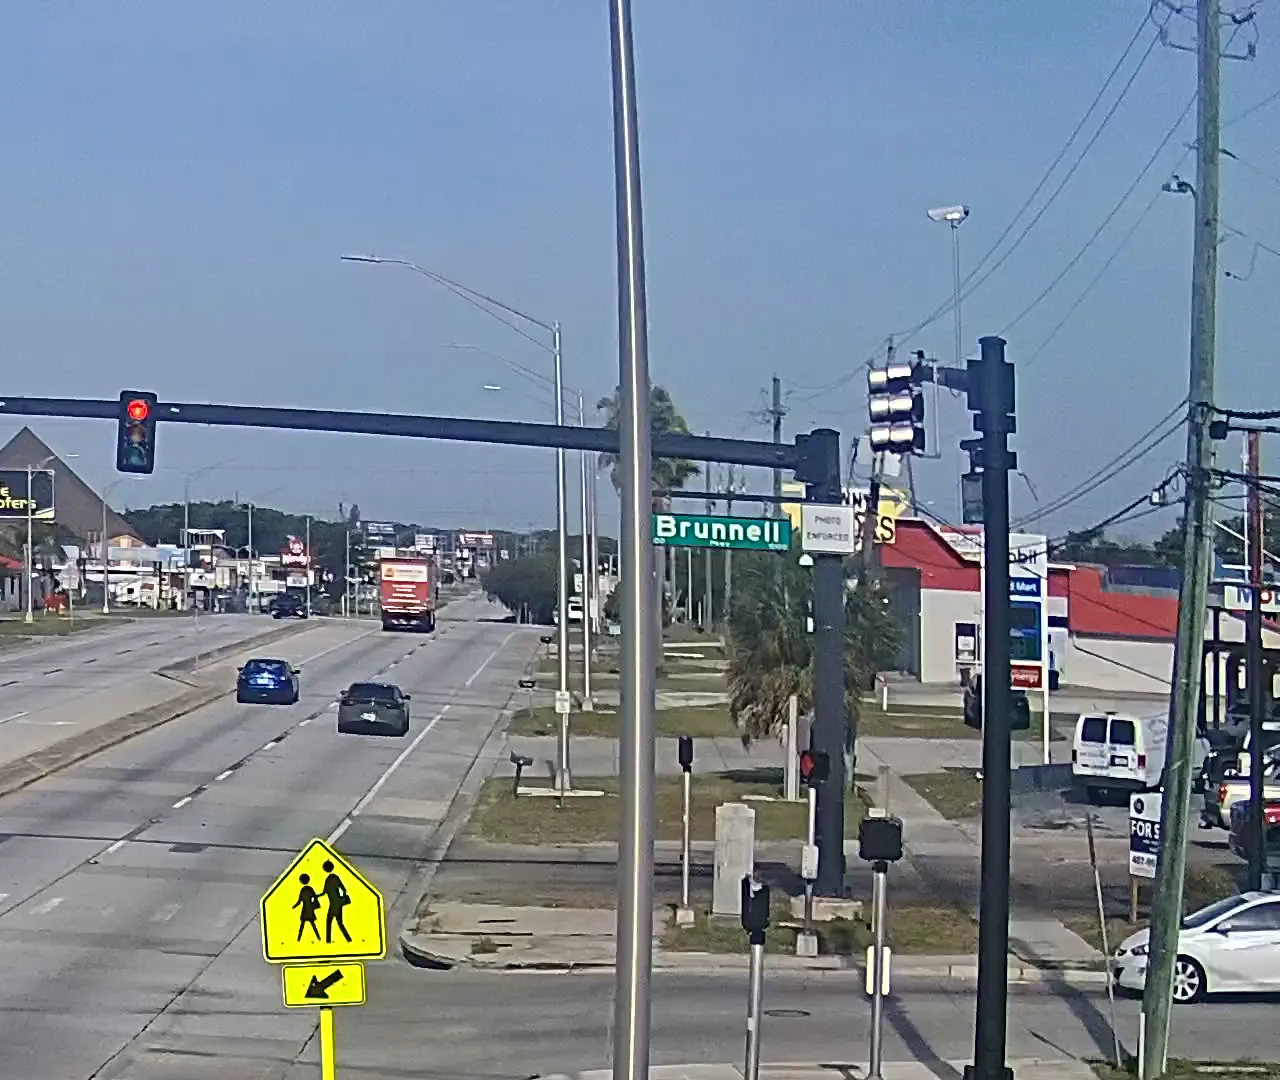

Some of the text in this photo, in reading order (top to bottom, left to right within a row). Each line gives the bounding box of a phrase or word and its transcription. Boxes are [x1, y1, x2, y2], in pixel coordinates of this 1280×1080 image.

[656, 515, 779, 543] Brunnell
[814, 515, 841, 526] PHOTO
[1131, 819, 1152, 839] FOR
